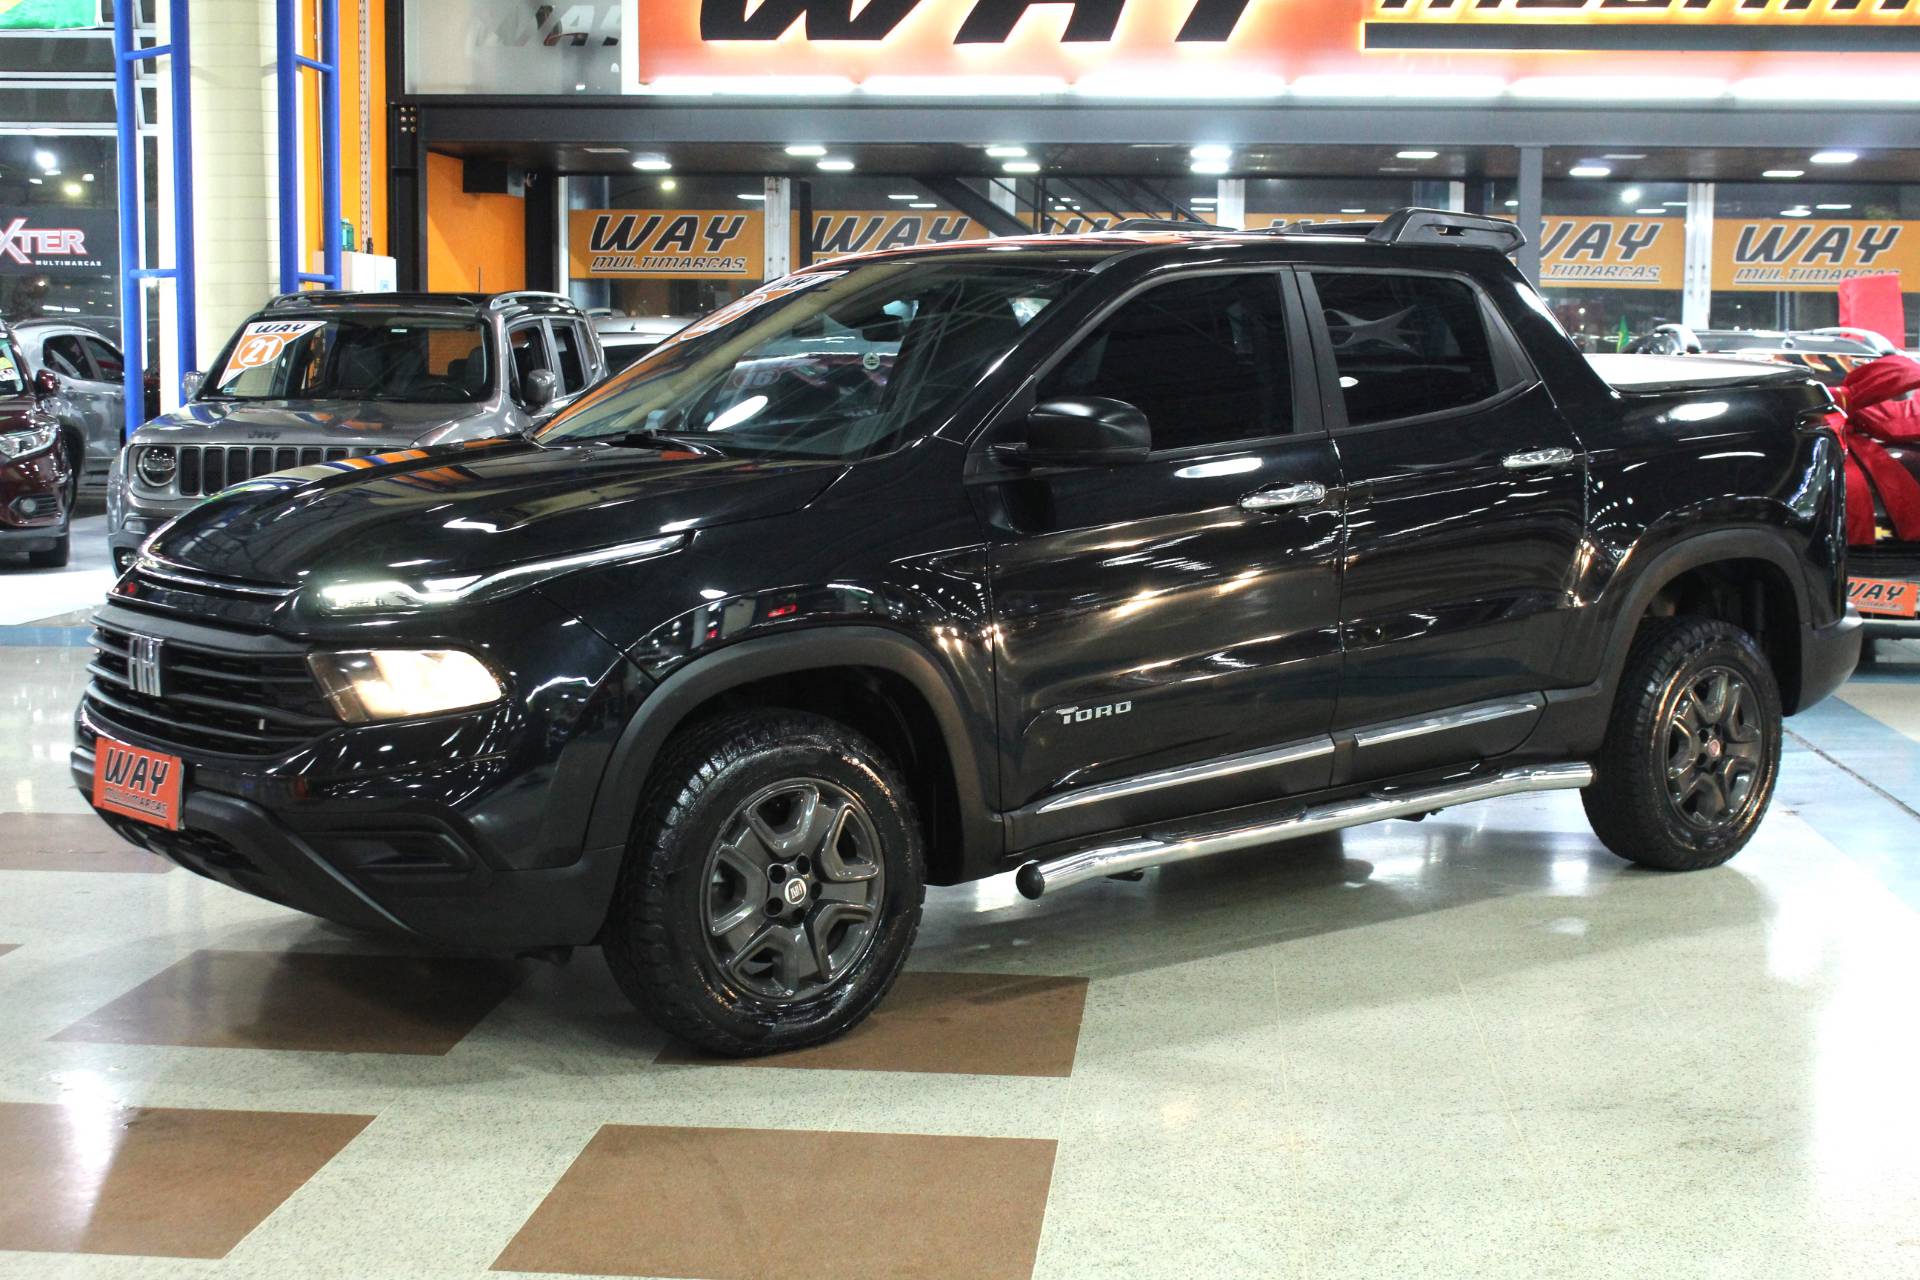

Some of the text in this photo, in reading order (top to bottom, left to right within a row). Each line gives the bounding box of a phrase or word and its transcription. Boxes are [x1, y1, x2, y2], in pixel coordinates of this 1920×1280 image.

[590, 215, 747, 253] WAY
[812, 216, 972, 253] WAY
[1735, 224, 1904, 265] WAY
[591, 256, 746, 269] MULTIMARCAS
[1541, 264, 1660, 279] TIMARCAS
[1736, 267, 1901, 281] MULTIMAR
[254, 323, 306, 334] WAY
[243, 338, 280, 363] 21
[104, 747, 169, 796] WAY
